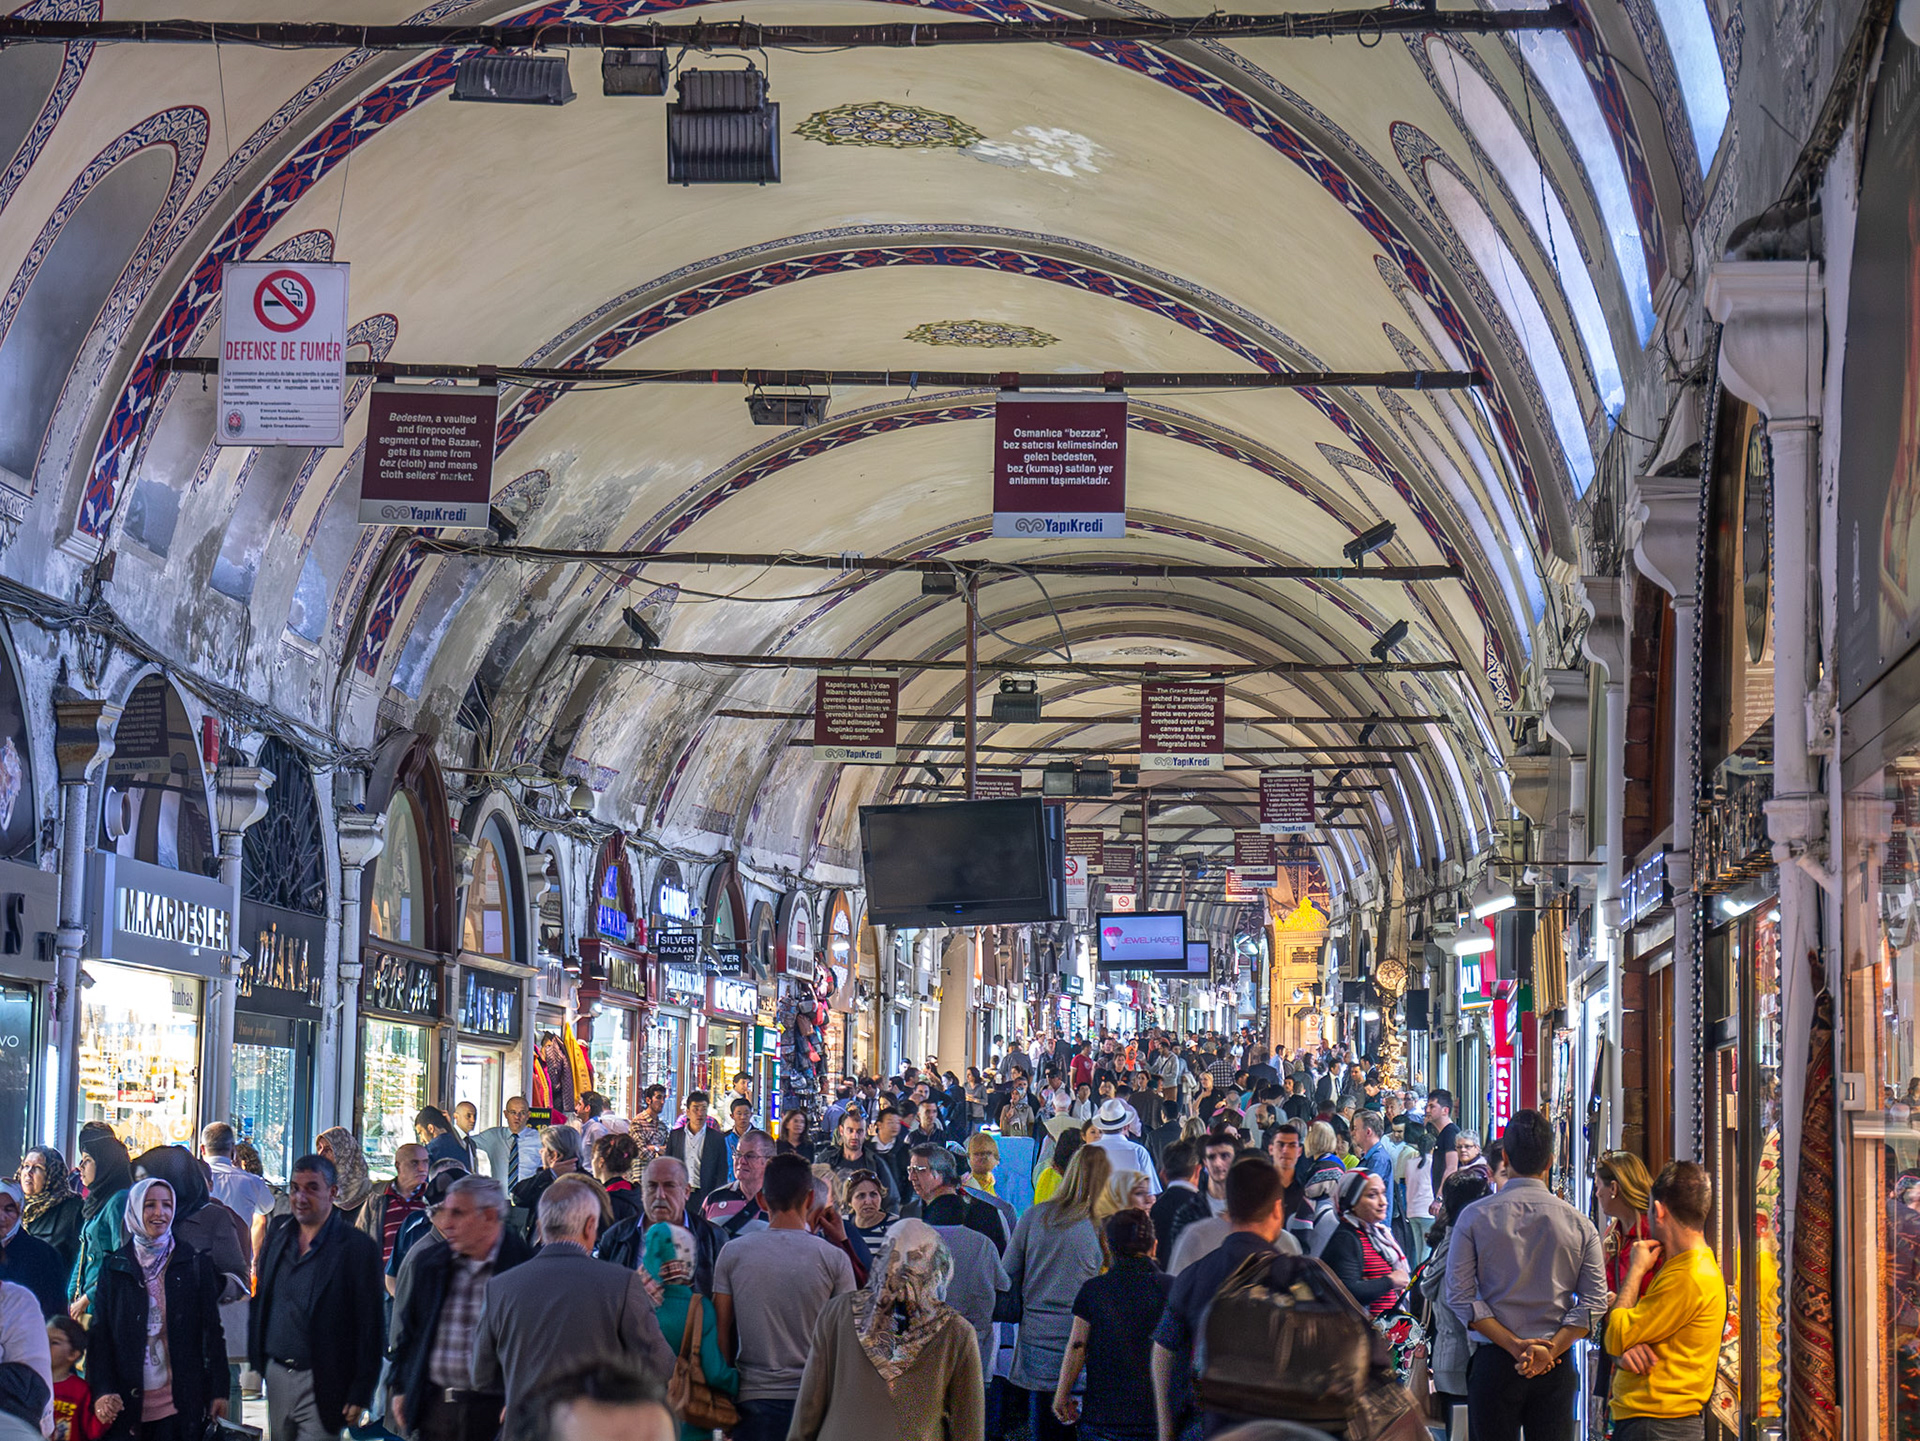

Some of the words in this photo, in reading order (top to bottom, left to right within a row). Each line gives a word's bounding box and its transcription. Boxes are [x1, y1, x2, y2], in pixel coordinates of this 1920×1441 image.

[226, 341, 276, 360] DEFENSE
[281, 342, 295, 360] DE
[301, 342, 340, 361] FUMER
[390, 413, 434, 423] Bedesten,
[417, 425, 466, 436] fireproofed
[1014, 429, 1062, 438] Osmanlıca
[379, 437, 418, 446] segment
[449, 439, 481, 448] Bazaar,
[1057, 441, 1118, 449] kelimesinden
[388, 449, 407, 457] gets
[410, 448, 421, 456] its
[1024, 453, 1049, 462] gelen
[1052, 453, 1097, 462] bedesten,
[397, 459, 426, 470] (cloth)
[1007, 464, 1023, 473] bez
[1026, 464, 1063, 475] (kumaş)
[1065, 465, 1096, 473] satılan
[1098, 467, 1113, 475] yer
[440, 473, 474, 481] market.
[1009, 477, 1048, 485] anlamını
[411, 507, 467, 522] YapıKredi
[1045, 519, 1102, 533] YapıKredi
[846, 750, 882, 759] YapıKredi
[1173, 758, 1209, 767] YapıKredi
